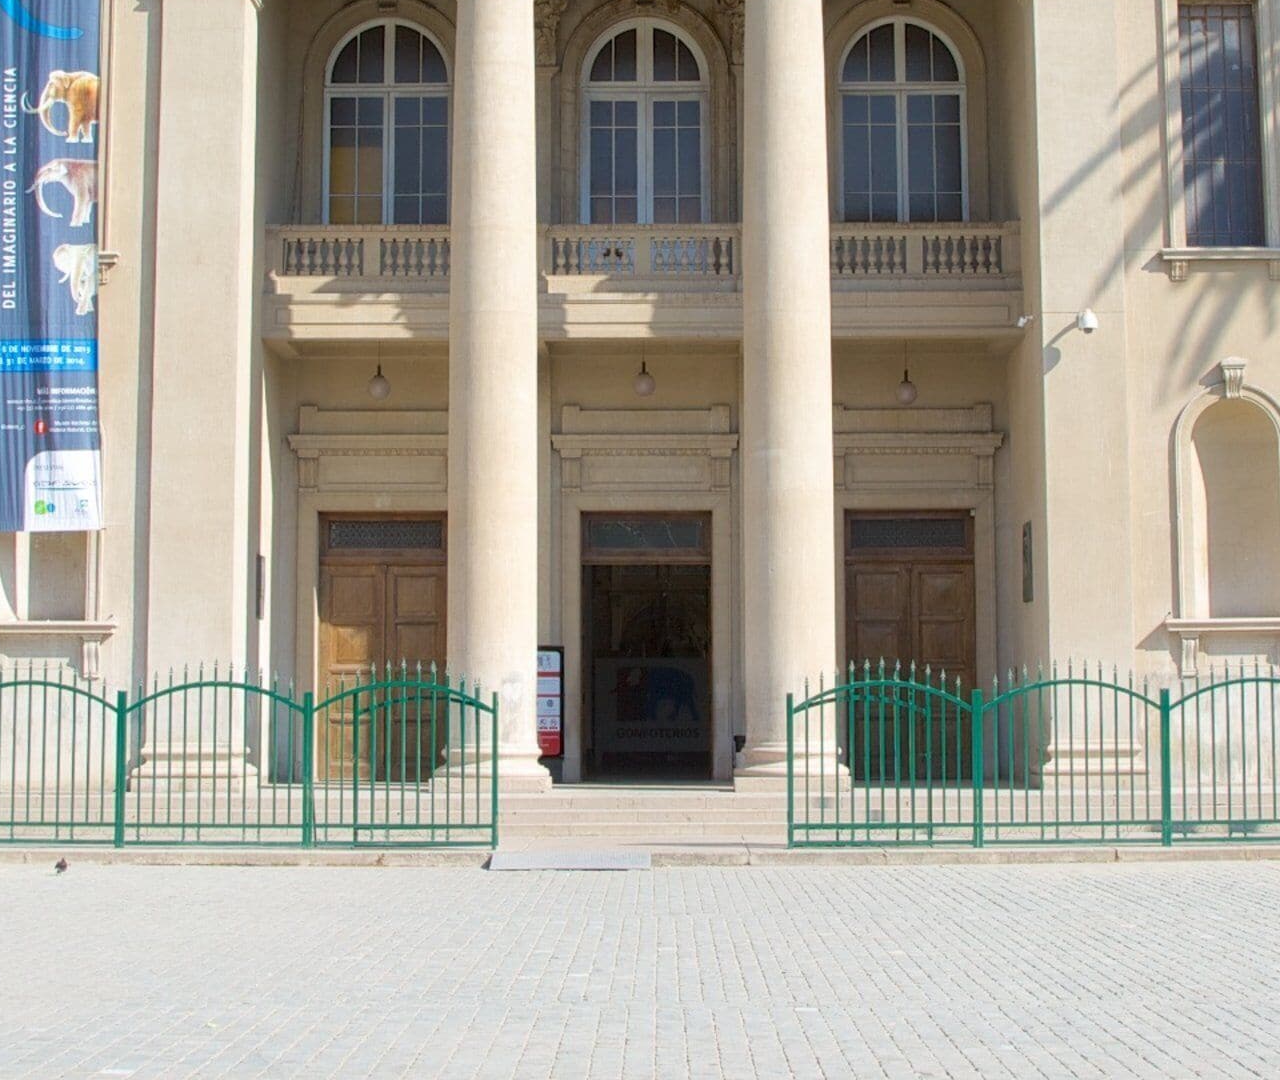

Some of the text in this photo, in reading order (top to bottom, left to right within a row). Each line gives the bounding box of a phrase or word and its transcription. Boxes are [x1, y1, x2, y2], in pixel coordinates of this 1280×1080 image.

[2, 67, 17, 309] DEL IMAGINARIO A LA CIENCIA
[9, 345, 18, 353] DE
[61, 345, 71, 353] DE
[17, 357, 27, 365] DE
